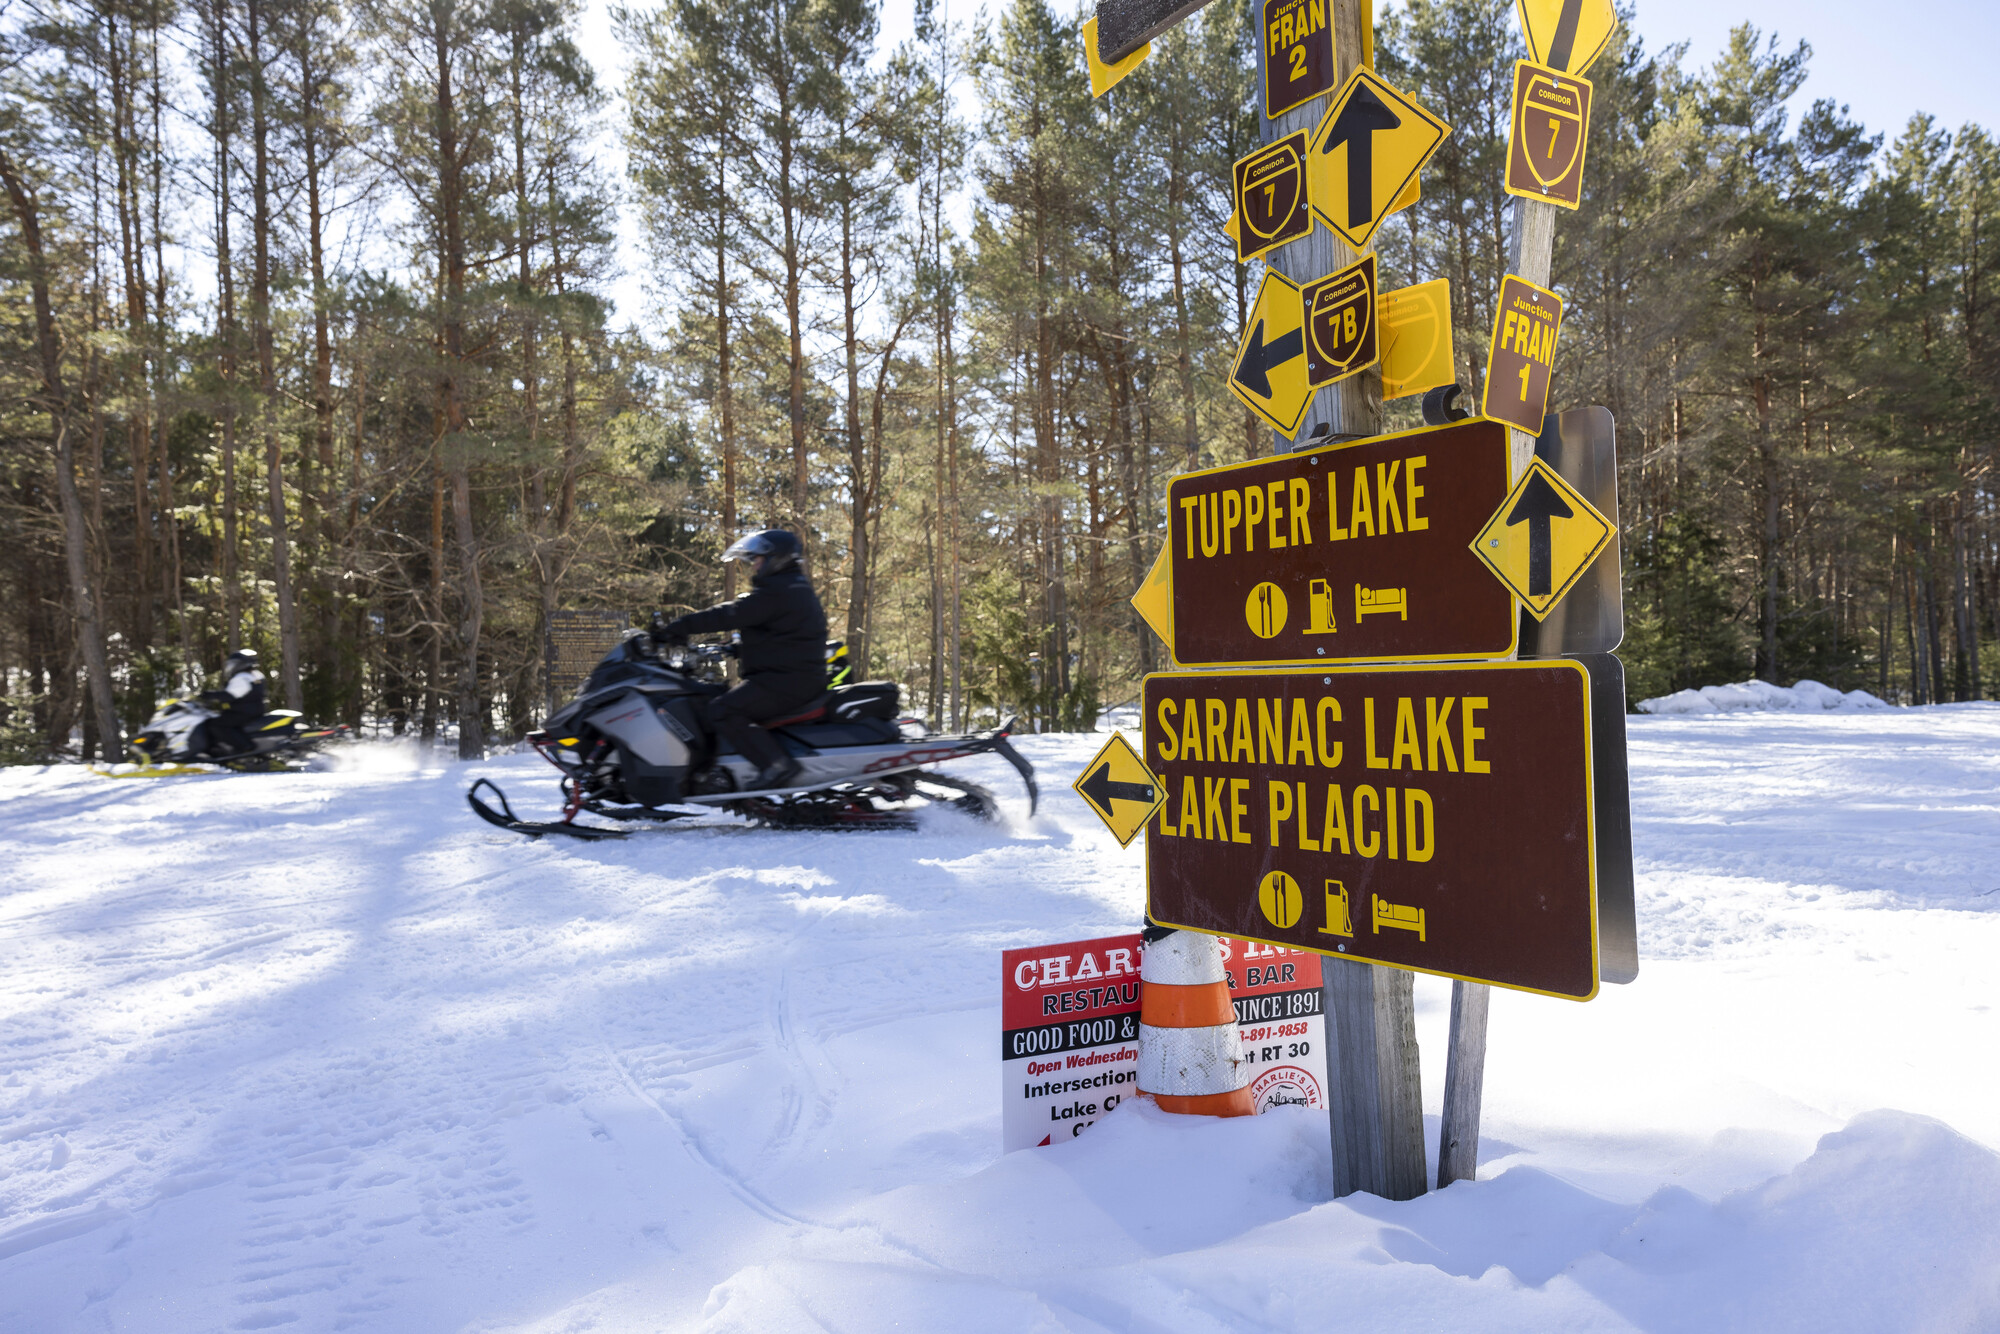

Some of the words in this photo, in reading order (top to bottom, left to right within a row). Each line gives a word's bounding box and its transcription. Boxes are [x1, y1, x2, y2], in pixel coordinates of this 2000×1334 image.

[1270, 0, 1326, 56] FRAN
[1274, 0, 1305, 18] Junc
[1289, 44, 1308, 83] 2
[1538, 88, 1571, 106] CORRIDOR
[1547, 117, 1561, 159] 7
[1252, 157, 1285, 177] CORRIDOR
[1264, 182, 1275, 218] 7
[1324, 282, 1357, 301] CORRIDOR
[1513, 296, 1553, 322] Junction
[1329, 306, 1357, 349] 7B
[1501, 309, 1555, 367] FRAN
[1519, 363, 1531, 402] 1
[1180, 477, 1312, 559] TUPPER
[1328, 455, 1429, 542] LAKE
[1157, 696, 1343, 768] SARANAC
[1364, 696, 1491, 774] LAKE
[1158, 774, 1252, 844] LAKE
[1269, 780, 1435, 863] PLACID
[1014, 946, 1141, 991] CHAR
[1042, 982, 1140, 1016] RESTAU
[1246, 962, 1296, 988] BAR
[1013, 1026, 1063, 1055] GOOD
[1069, 1019, 1116, 1047] FOOD
[1120, 1015, 1136, 1040] &
[1233, 995, 1282, 1022] SINCE
[1286, 991, 1320, 1016] 1891
[1025, 1070, 1137, 1098] Intersection
[1262, 1045, 1283, 1062] RT
[1288, 1041, 1310, 1058] 30
[1027, 1060, 1062, 1076] Open
[1066, 1046, 1138, 1069] Wednesday
[1253, 1071, 1306, 1099] CHARLIE'S
[1306, 1084, 1317, 1104] INN
[1051, 1101, 1097, 1120] Lake
